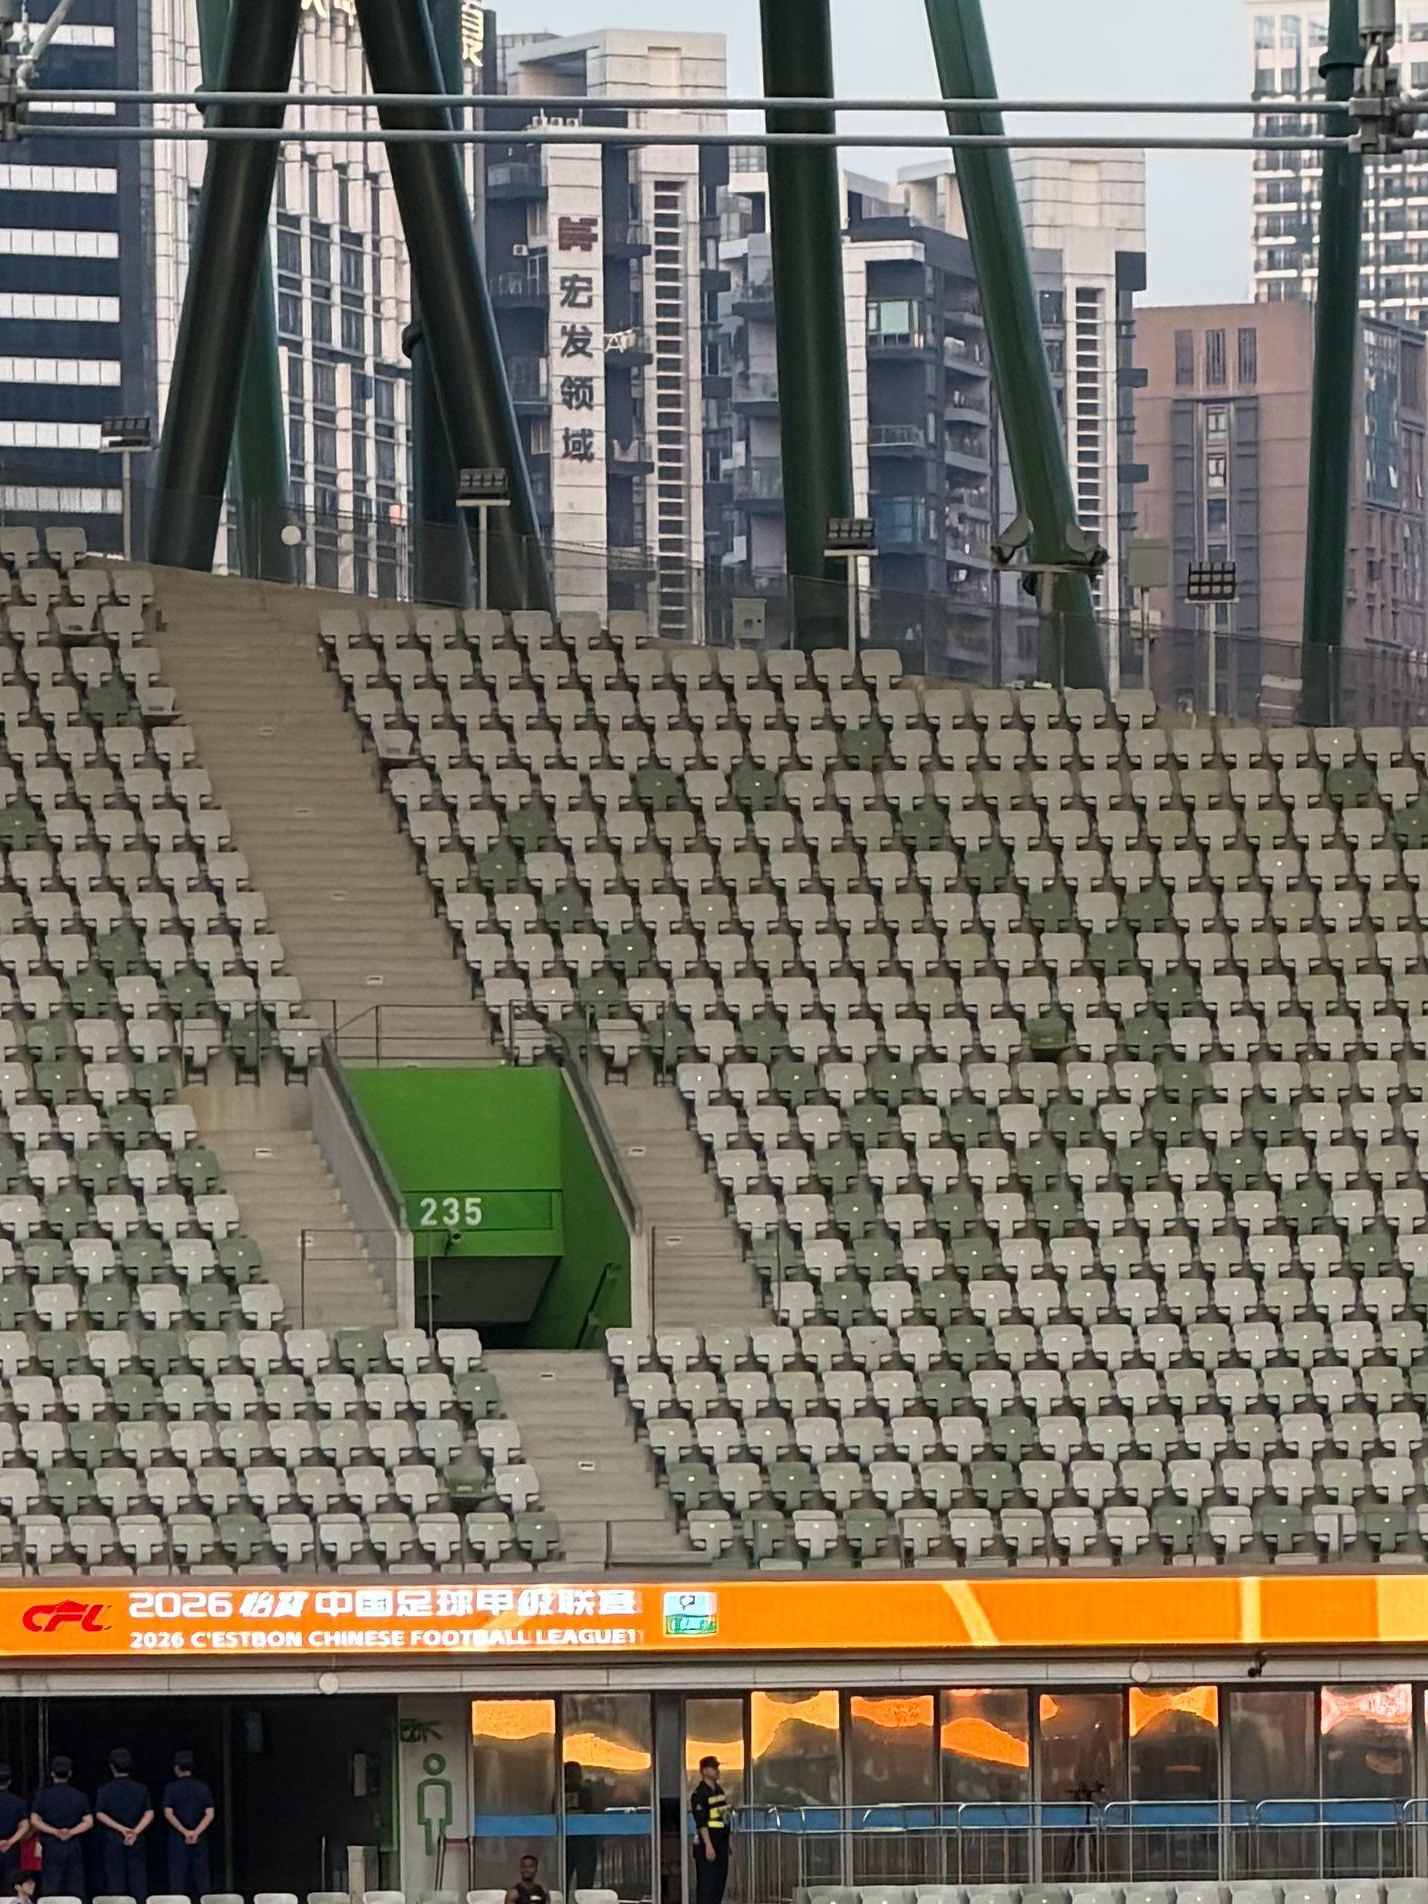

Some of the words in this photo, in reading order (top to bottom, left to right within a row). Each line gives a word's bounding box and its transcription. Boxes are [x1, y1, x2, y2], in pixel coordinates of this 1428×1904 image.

[559, 273, 595, 463] 宏发领域
[420, 1197, 483, 1226] 235
[128, 1591, 234, 1618] 2026
[129, 1631, 185, 1649] 2026
[190, 1630, 304, 1649] C'ESTBON
[308, 1629, 405, 1648] CHINESE
[410, 1628, 533, 1647] FOOTBALL
